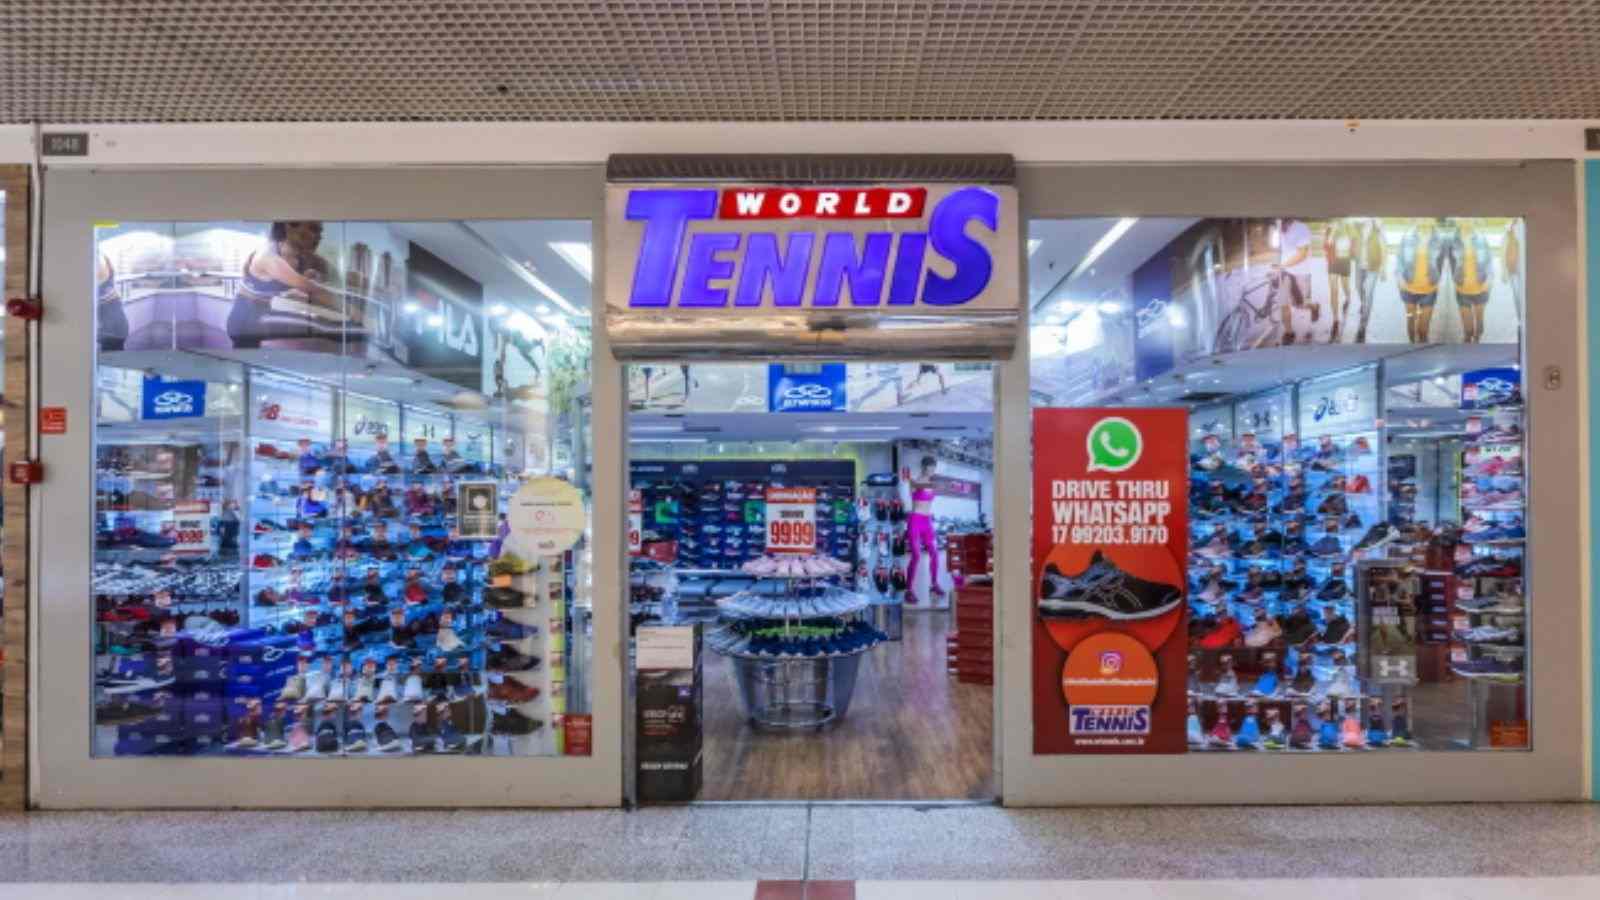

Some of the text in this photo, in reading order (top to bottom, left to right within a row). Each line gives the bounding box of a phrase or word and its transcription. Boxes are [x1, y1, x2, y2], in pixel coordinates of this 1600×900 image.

[736, 192, 912, 215] WORLD
[625, 186, 999, 307] TENNIS
[1052, 480, 1169, 499] DRIVE THRU
[1052, 500, 1171, 523] WHATSAPP
[1052, 525, 1168, 543] 17 99203.9170
[1072, 708, 1147, 731] TENNIS
